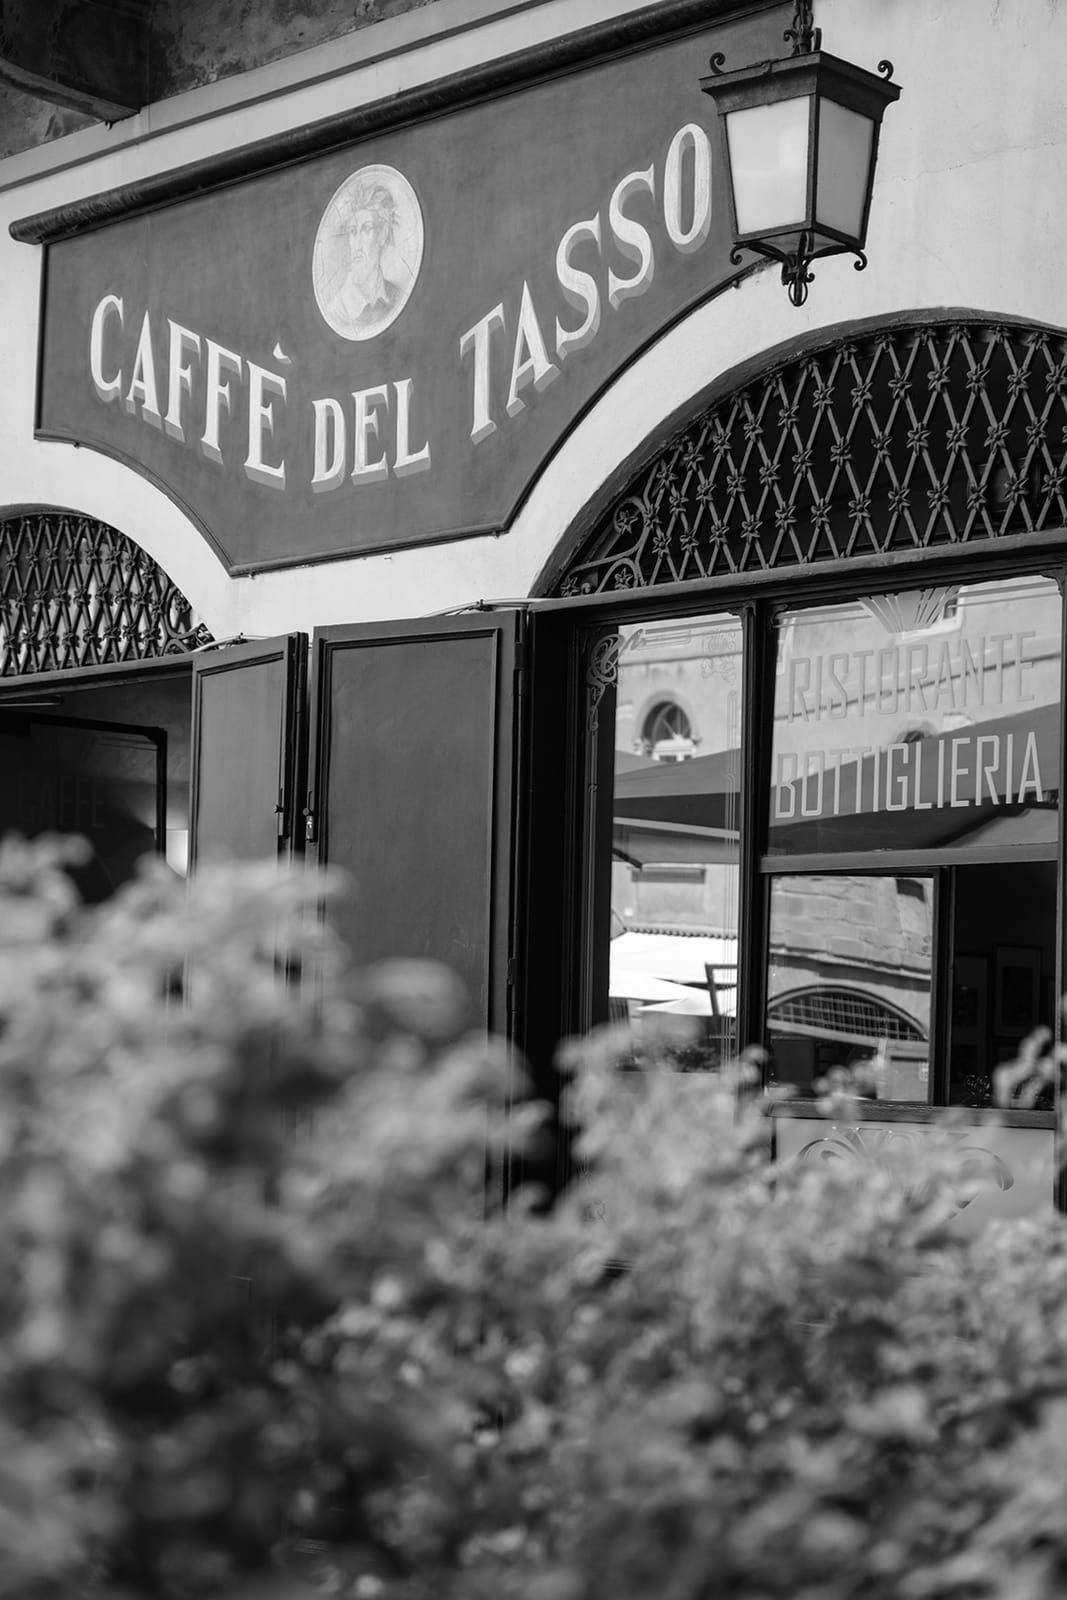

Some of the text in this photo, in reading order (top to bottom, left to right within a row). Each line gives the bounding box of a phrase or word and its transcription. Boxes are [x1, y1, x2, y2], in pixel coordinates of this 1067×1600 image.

[90, 122, 712, 492] CAFFÈ DEL TASSO
[787, 630, 1036, 724] RISTORANTE
[774, 731, 1044, 819] BOTTIGLIERIA
